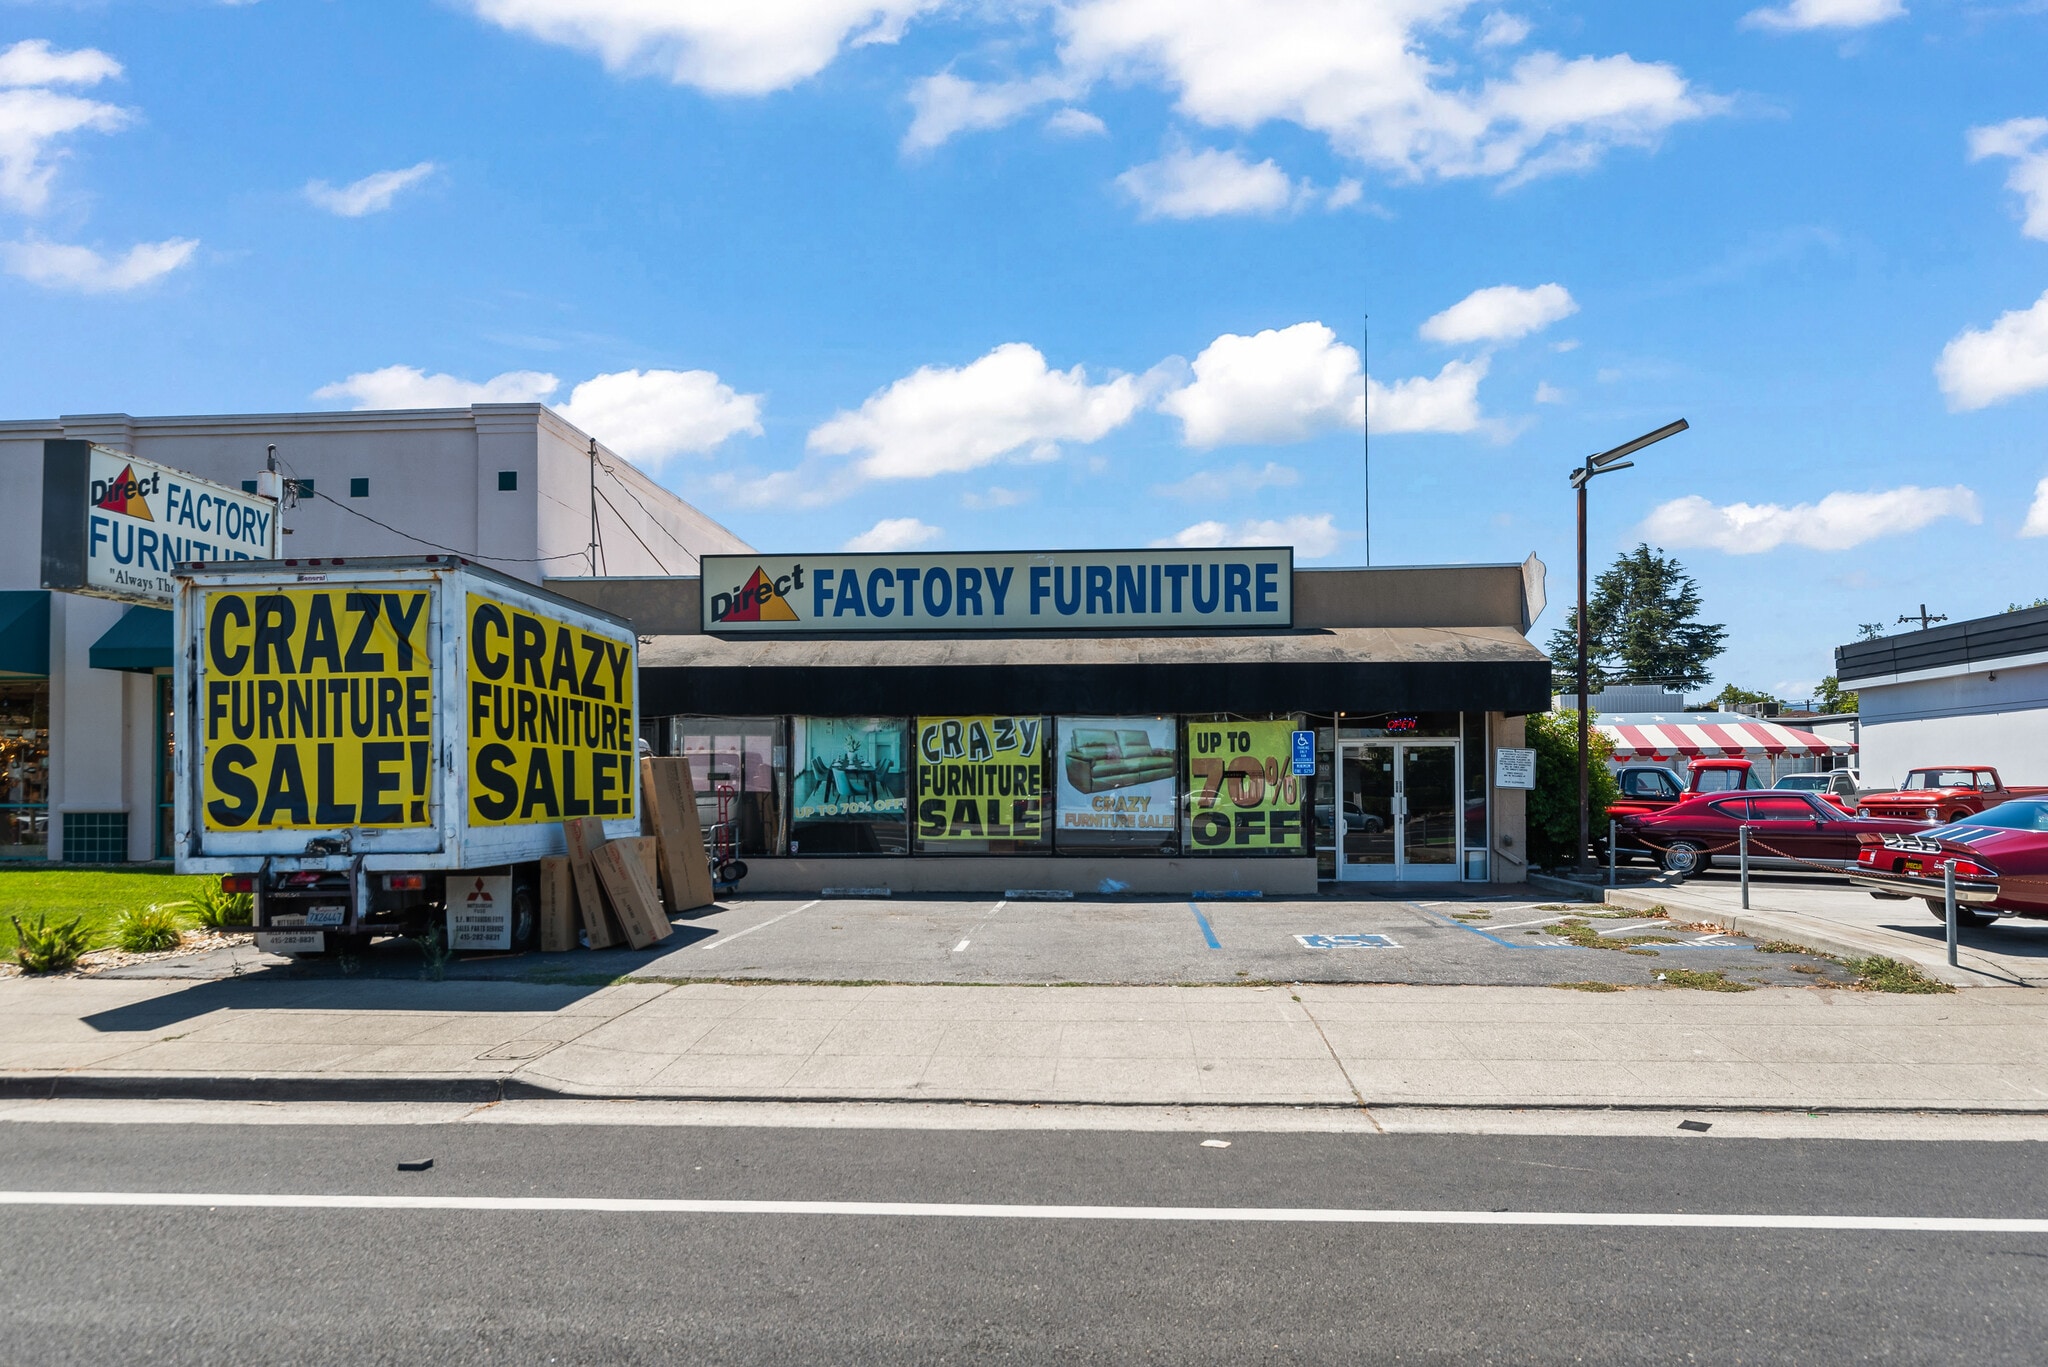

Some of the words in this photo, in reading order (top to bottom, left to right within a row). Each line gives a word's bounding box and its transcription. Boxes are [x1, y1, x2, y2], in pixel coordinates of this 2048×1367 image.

[91, 472, 160, 506] Direct
[167, 482, 270, 547] FACTORY
[711, 564, 804, 623] Direct
[812, 566, 1014, 618] FACTORY
[1028, 563, 1278, 616] FURNITURE
[209, 593, 428, 676] CRAZY
[471, 603, 631, 704] CRAZY
[209, 677, 430, 740] FURNITURE
[472, 681, 632, 751] FURNITURE
[1388, 720, 1416, 728] OPEN
[920, 718, 1040, 764] CRAZY
[1197, 732, 1222, 754] UP
[1227, 731, 1250, 752] TO
[207, 741, 430, 827] SALE!
[474, 743, 632, 822] SALE!
[920, 764, 1040, 797] FURNITURE
[1192, 756, 1297, 809] 70%
[795, 806, 815, 818] UP
[817, 804, 838, 816] TO
[840, 800, 872, 814] 70%
[920, 798, 1040, 837] SALE
[1065, 813, 1136, 828] FURNITURE
[1092, 796, 1151, 812] CRAZY
[1192, 811, 1300, 846] OFF
[310, 912, 341, 922] 7X26447
